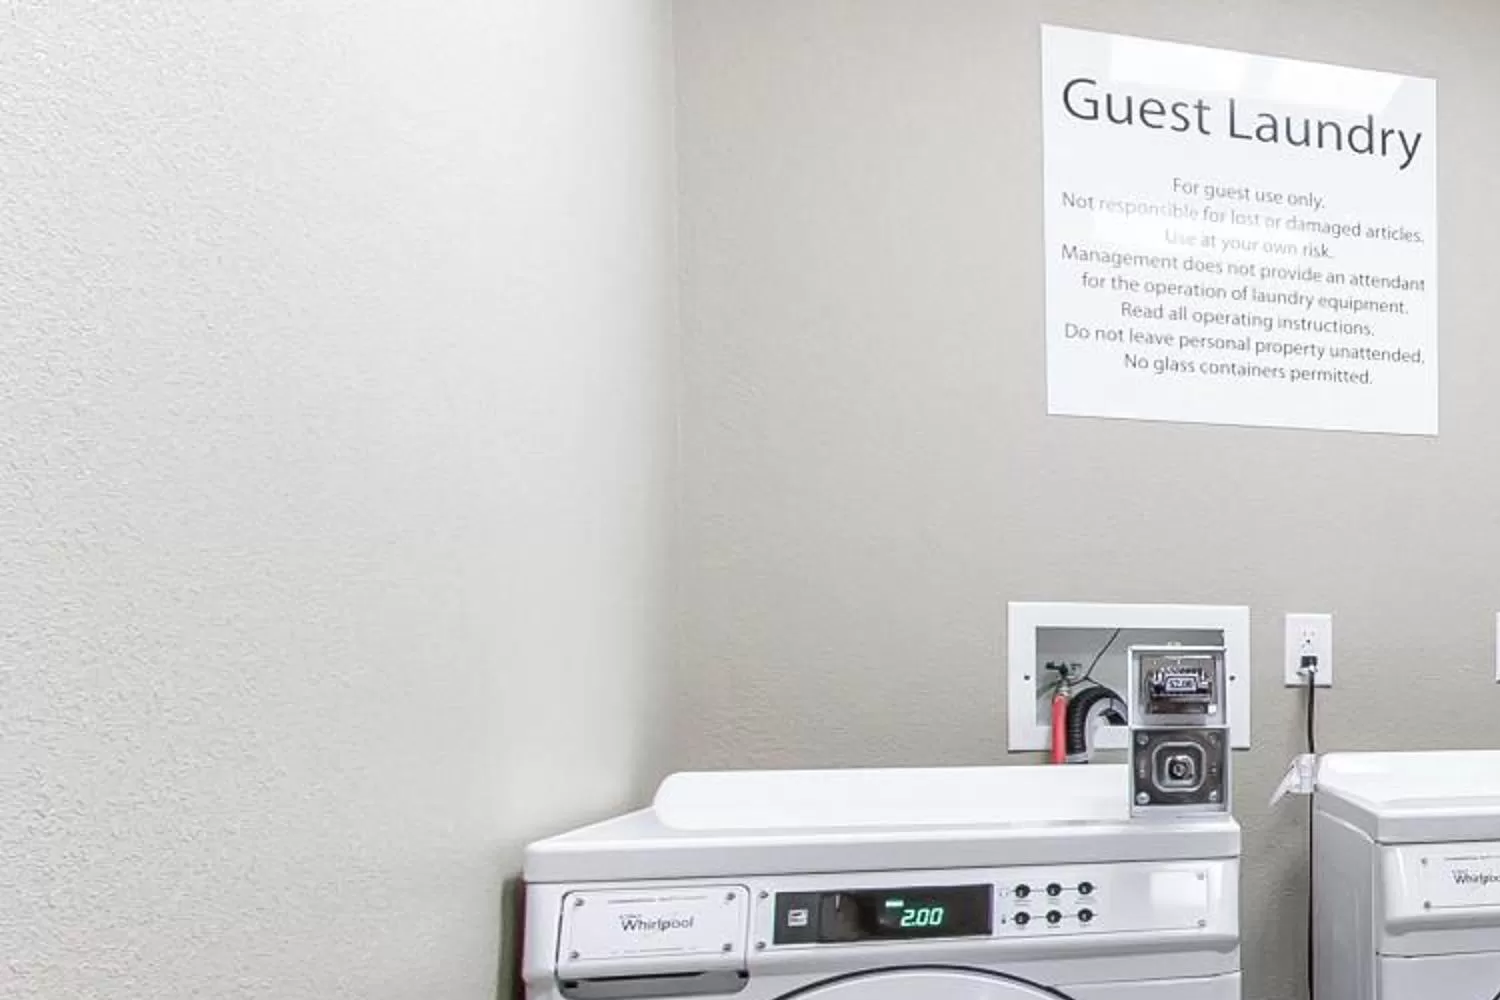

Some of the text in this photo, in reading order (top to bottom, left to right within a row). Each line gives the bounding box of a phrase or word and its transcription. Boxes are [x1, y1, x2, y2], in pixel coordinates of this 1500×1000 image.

[1061, 77, 1423, 170] Guest Laundry
[1173, 177, 1325, 211] For guest use only.
[1062, 191, 1425, 244] Not responsible for lost or damaged articles.
[1165, 228, 1335, 259] Use at your own risk.
[1061, 243, 1425, 292] Management does not provide an attendant
[1082, 272, 1409, 316] for the operation of laundry equipment.
[1121, 301, 1375, 337] Read all operating instructions.
[1064, 323, 1425, 365] Do not leave personal property unattended.
[1124, 353, 1372, 386] No glass containers permitted.
[620, 915, 695, 932] Whirlpool
[900, 907, 945, 928] 2.00
